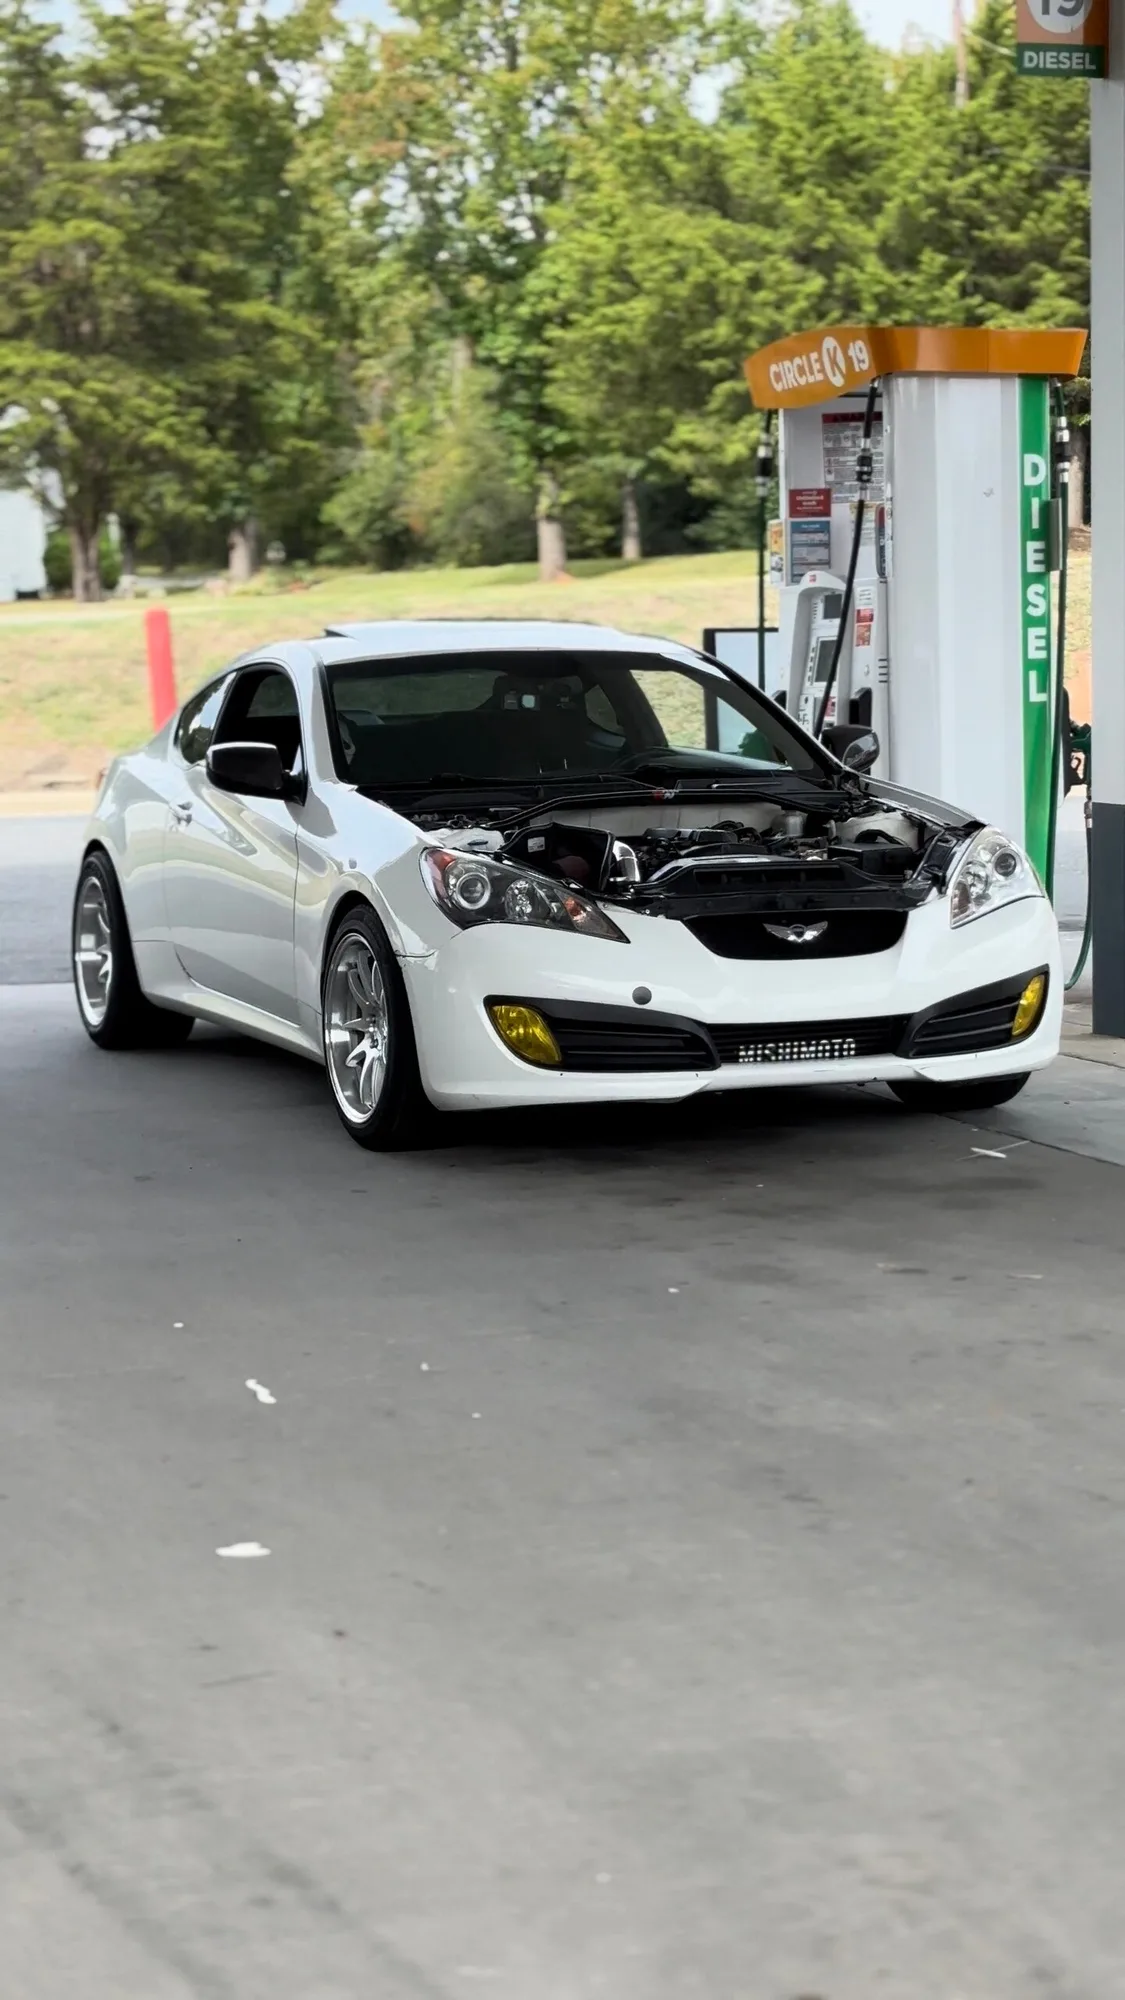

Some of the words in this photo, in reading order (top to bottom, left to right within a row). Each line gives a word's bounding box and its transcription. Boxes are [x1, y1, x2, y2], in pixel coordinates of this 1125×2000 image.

[1023, 51, 1096, 70] DIESEL
[769, 351, 824, 392] CIRCLE
[824, 339, 846, 385] K
[847, 339, 869, 372] 19
[1023, 453, 1048, 703] DIESEL
